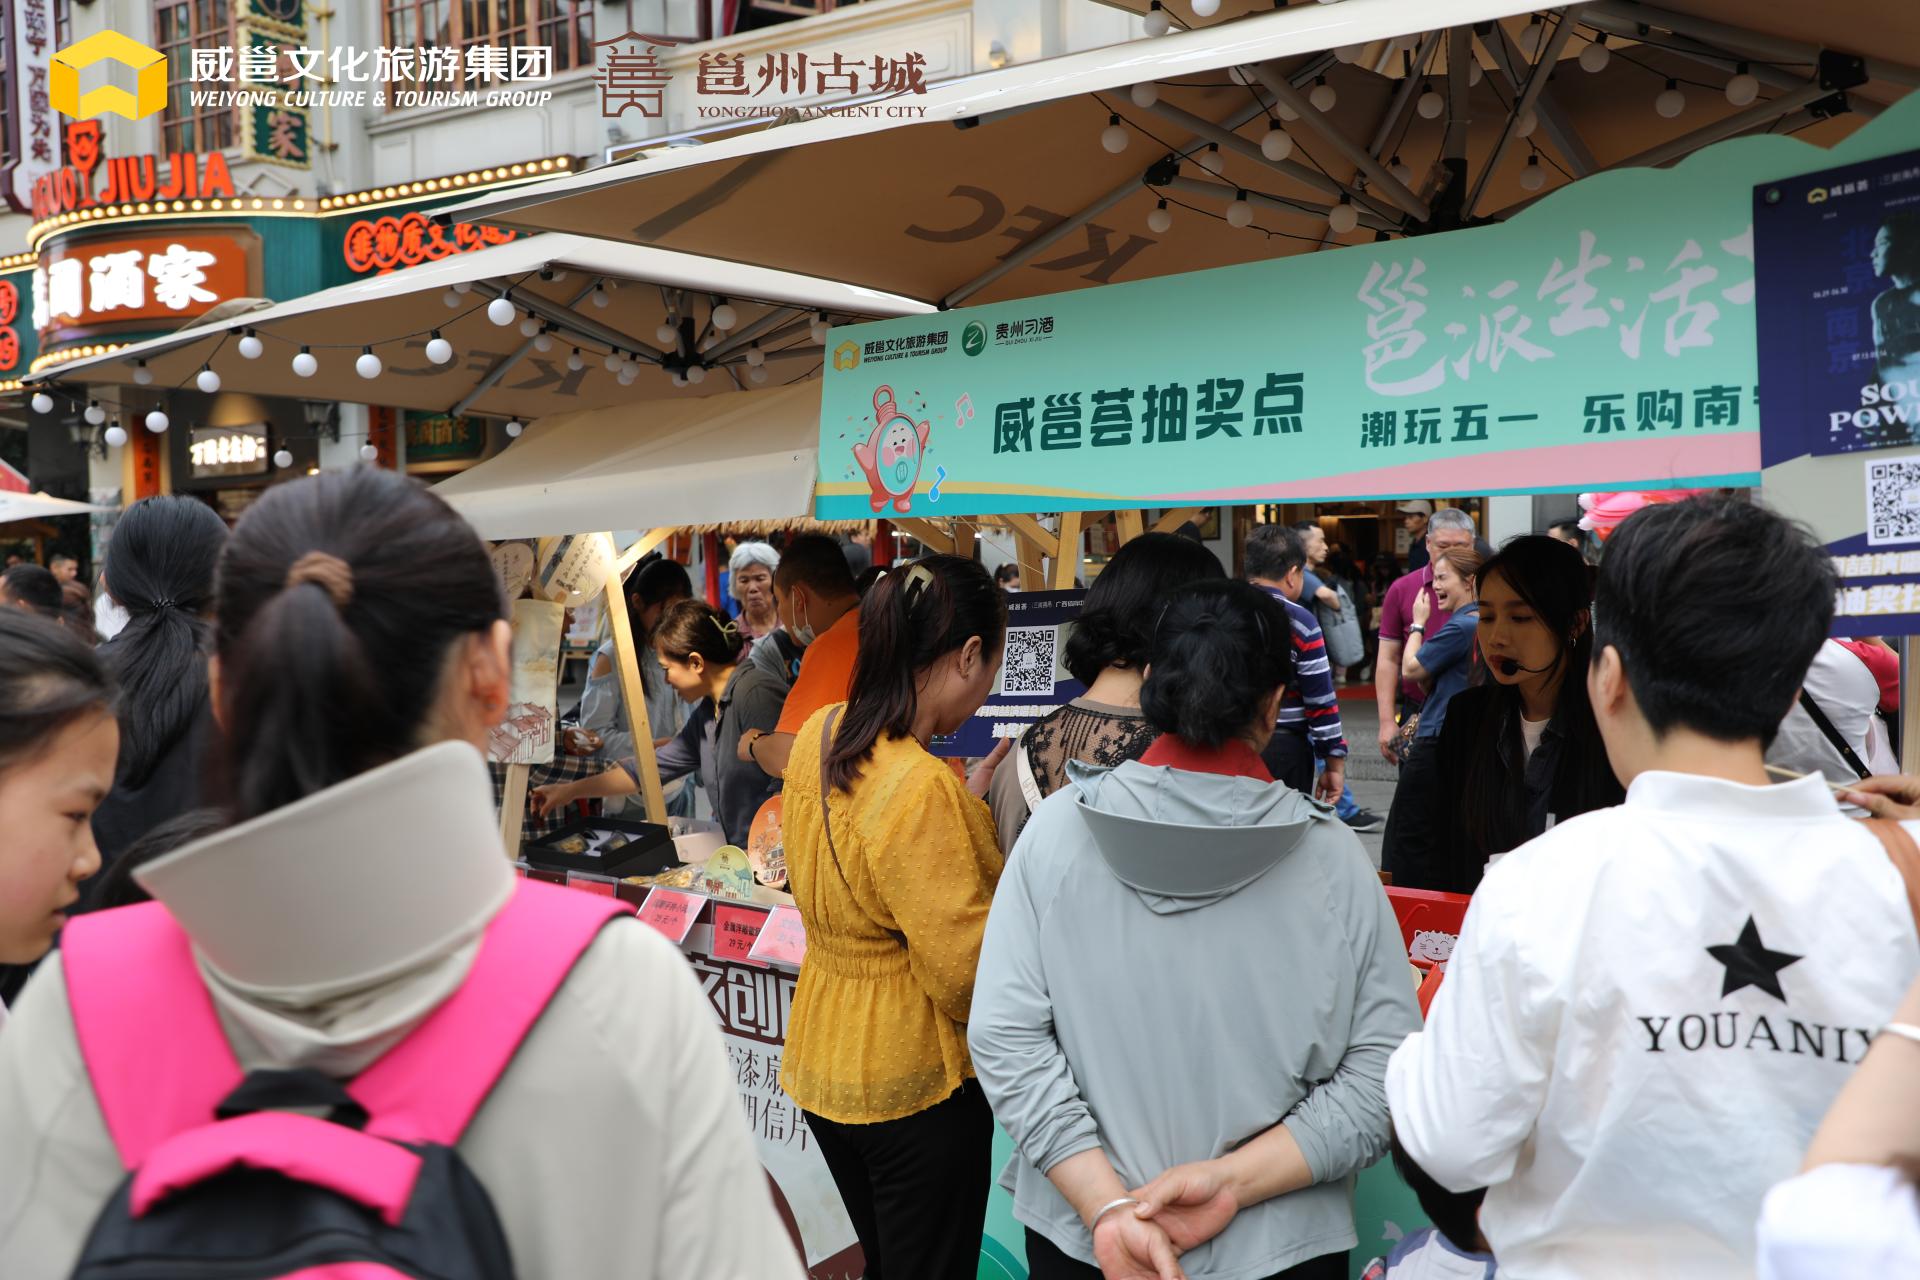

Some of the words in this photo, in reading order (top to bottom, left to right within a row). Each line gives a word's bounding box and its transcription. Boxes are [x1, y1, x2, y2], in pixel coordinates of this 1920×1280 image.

[995, 316, 1054, 340] 贵州习酒
[864, 331, 949, 355] 威邕文化旅游集团
[993, 372, 1304, 454] 威邕荟抽奖点
[1361, 403, 1538, 448] 潮玩五一
[1583, 384, 1759, 434] 乐购南
[1829, 403, 1920, 431] POW
